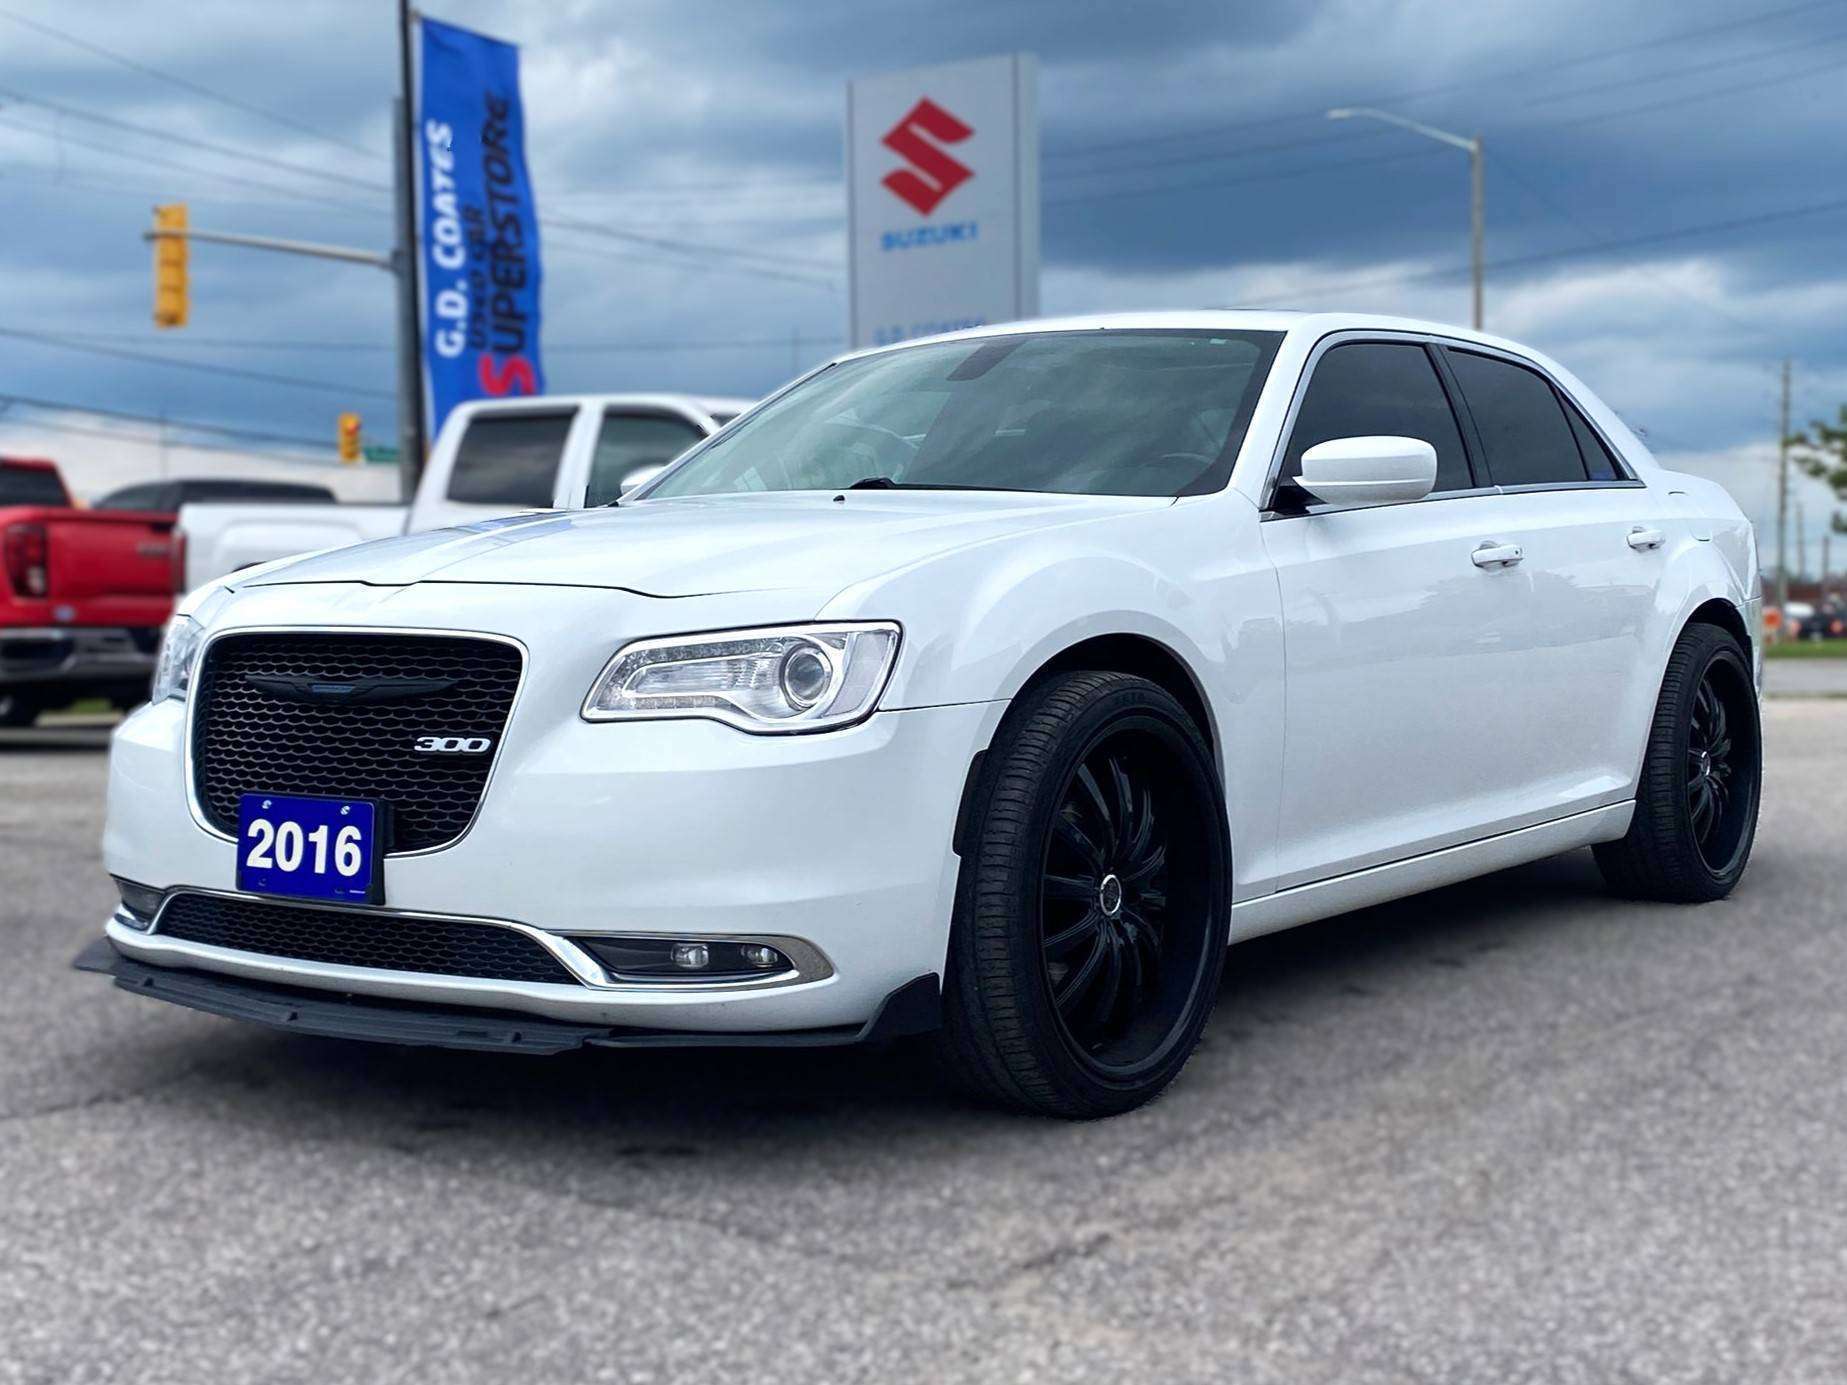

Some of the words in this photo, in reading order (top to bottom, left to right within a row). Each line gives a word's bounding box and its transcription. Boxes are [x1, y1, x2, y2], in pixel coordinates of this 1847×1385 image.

[426, 119, 465, 270] COATES
[478, 92, 535, 395] SUPERSTORE
[883, 222, 977, 250] SUZUKI
[434, 280, 467, 358] G.D.
[415, 737, 491, 752] 300
[247, 819, 362, 876] 2016
